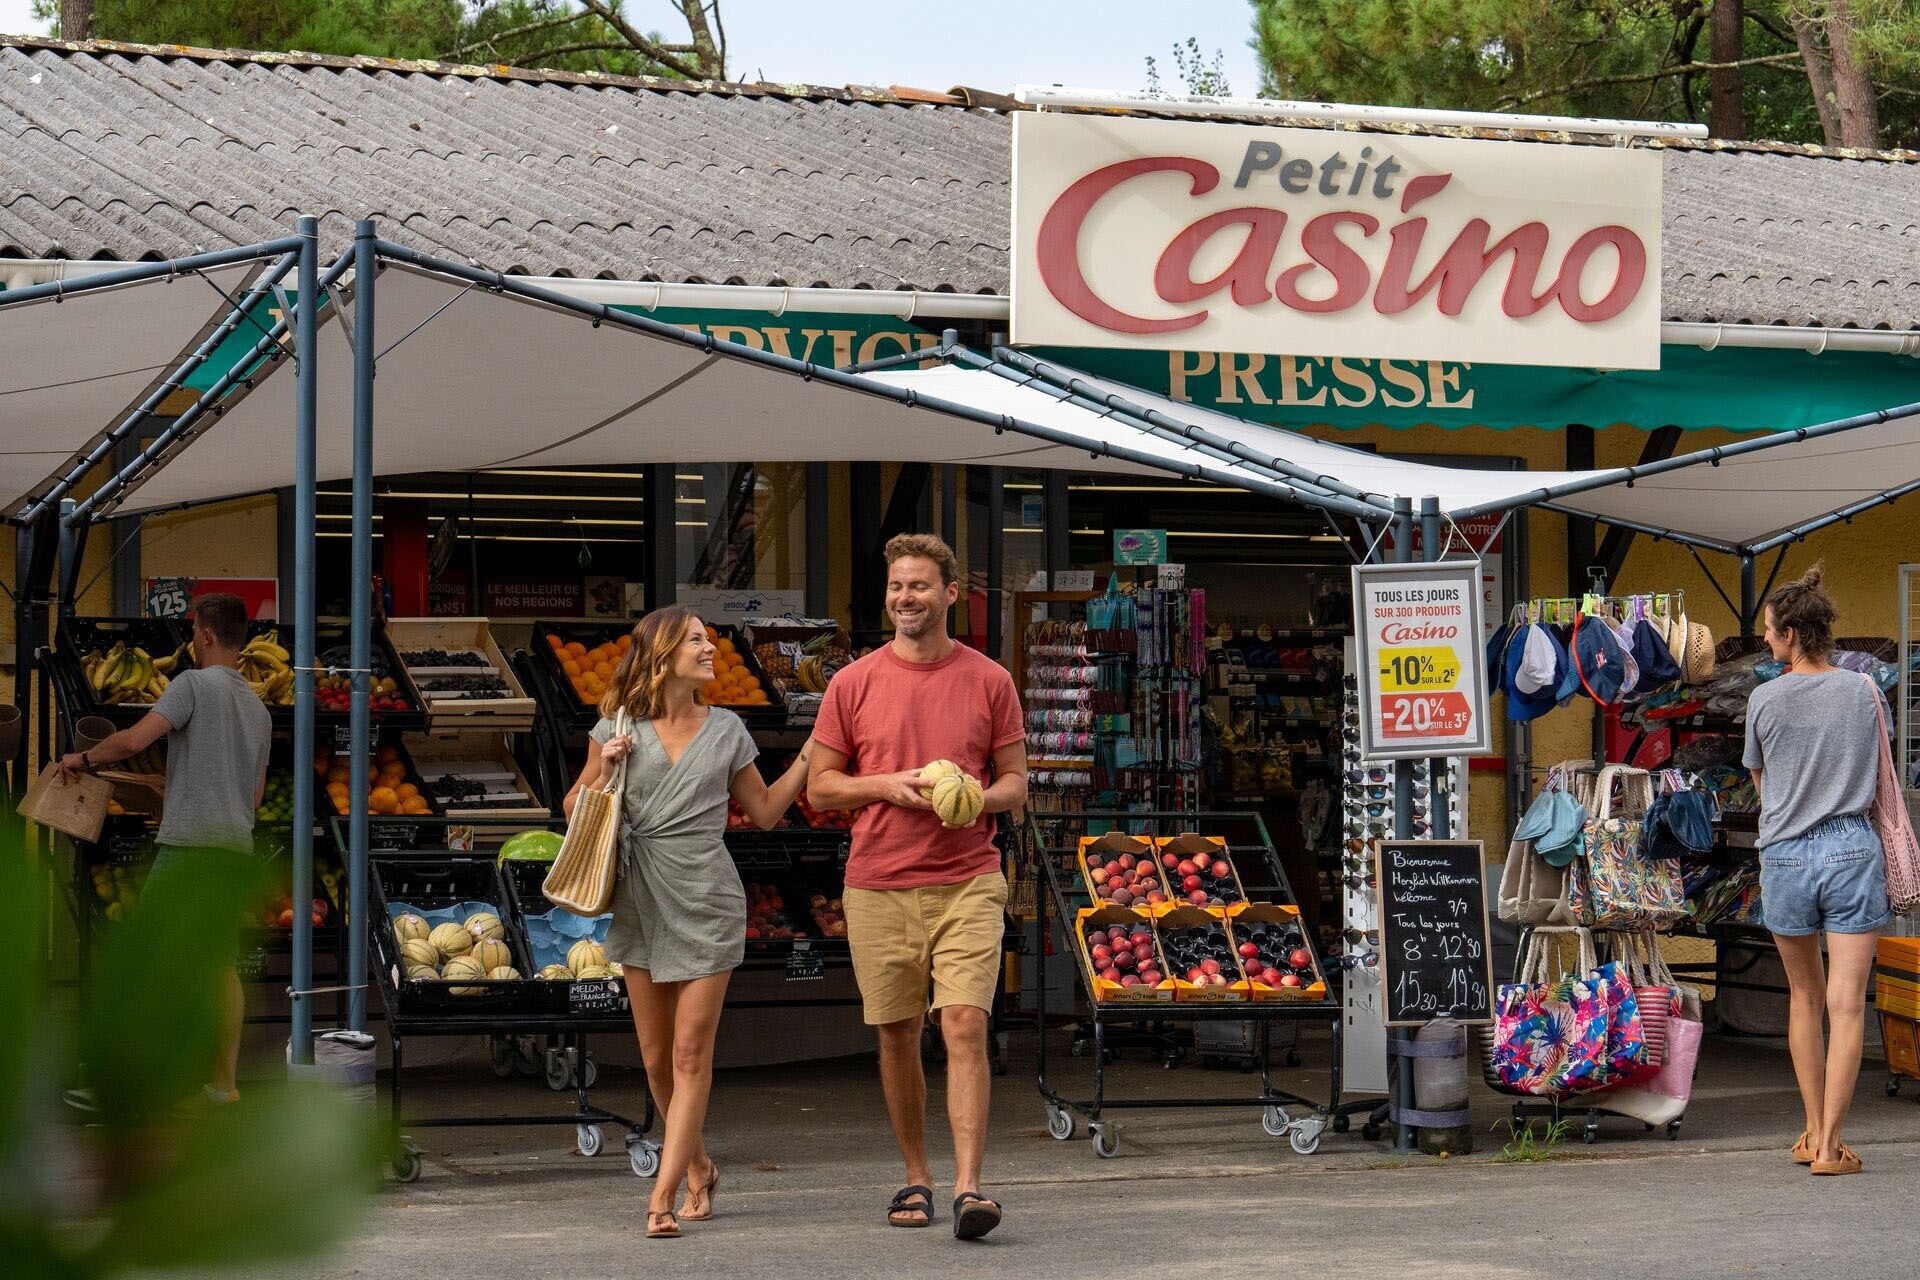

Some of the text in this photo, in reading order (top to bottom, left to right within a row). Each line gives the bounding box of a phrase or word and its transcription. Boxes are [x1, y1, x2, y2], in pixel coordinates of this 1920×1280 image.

[1234, 140, 1402, 199] Petit
[1036, 155, 1647, 334] Casino
[1168, 350, 1475, 410] PRESSE
[488, 584, 501, 594] LE
[505, 584, 561, 595] MEILLEUR
[1374, 588, 1459, 604] TOUS LES JOURS
[149, 590, 187, 617] 125
[495, 596, 574, 608] NOS REGIONS
[1374, 605, 1462, 618] SUR 300 PRODUITS
[1380, 620, 1458, 645] Casino
[1421, 676, 1435, 684] SUR
[1435, 676, 1442, 684] LE
[1429, 721, 1444, 730] SUR
[1444, 720, 1453, 729] LE
[1388, 850, 1452, 868] Bienvenue
[1448, 898, 1468, 918] 7/7
[1392, 913, 1460, 933] Tous les jours
[571, 982, 603, 994] MELON
